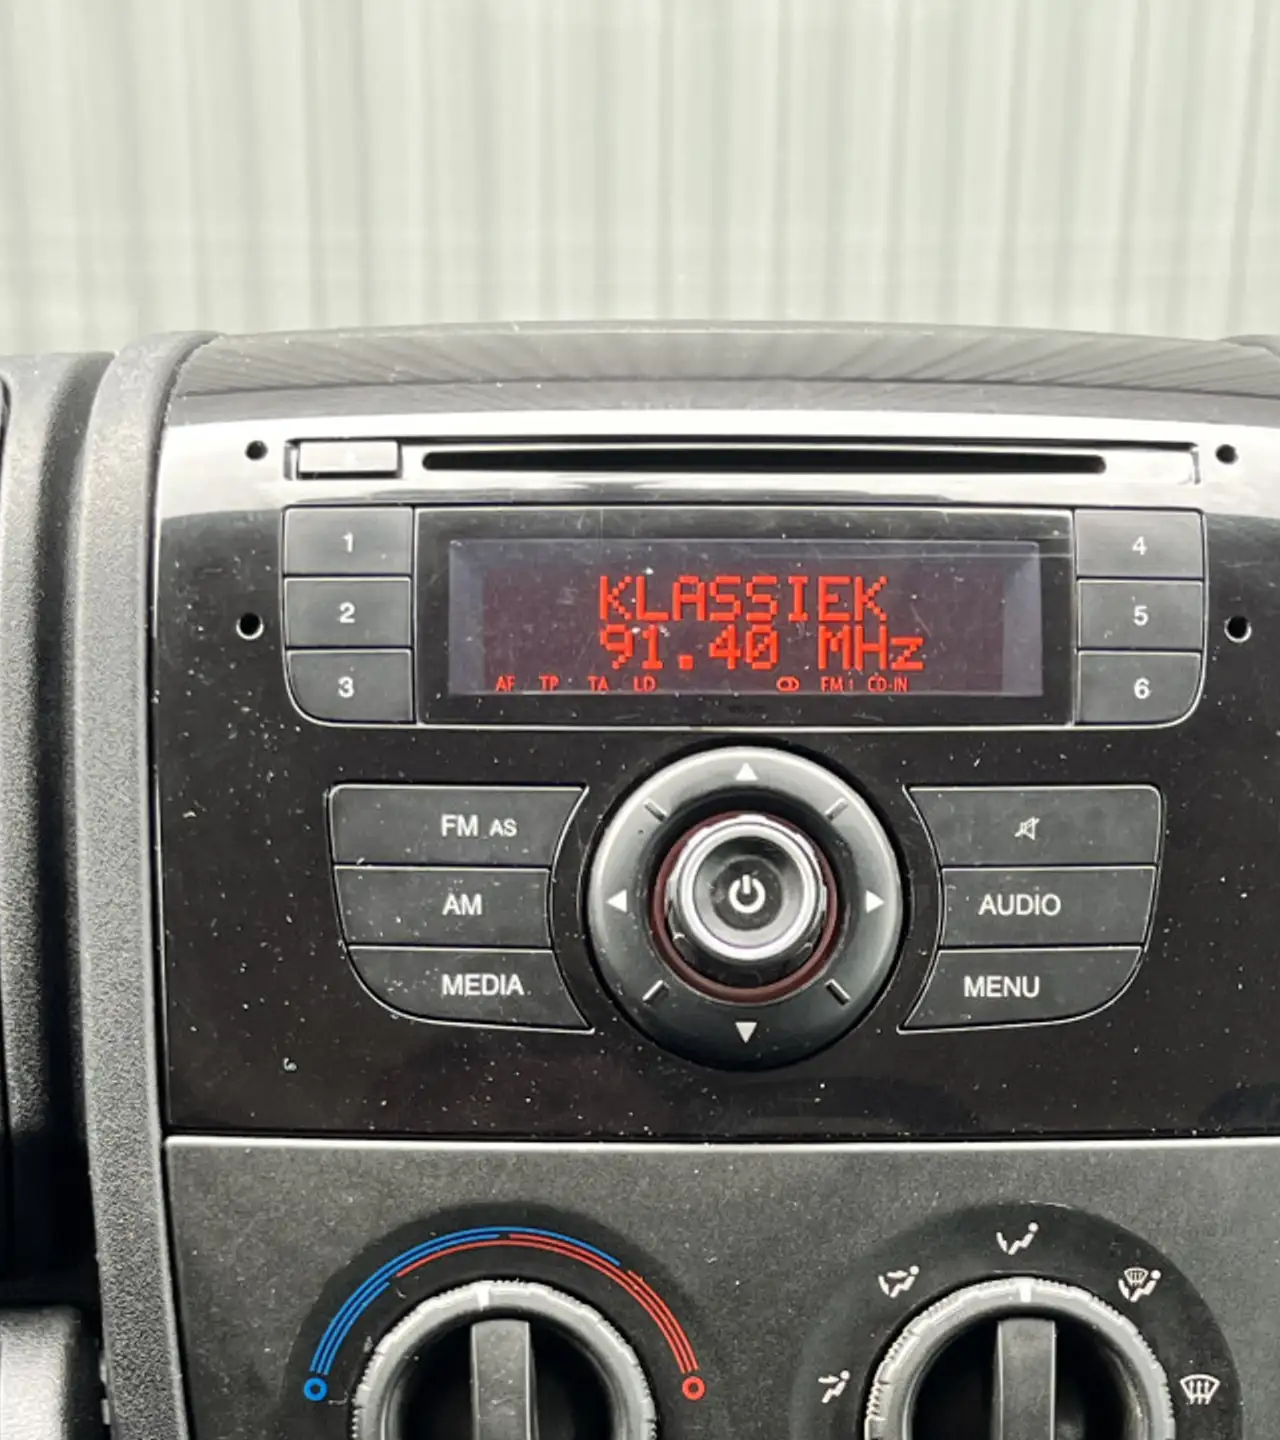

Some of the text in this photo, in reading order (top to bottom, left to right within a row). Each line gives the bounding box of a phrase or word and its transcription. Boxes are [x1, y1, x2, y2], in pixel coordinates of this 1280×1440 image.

[342, 532, 354, 553] 1
[1131, 535, 1148, 556] 4
[599, 575, 888, 621] KLASSIEK
[339, 601, 356, 624] 2
[1133, 604, 1149, 627] 5
[599, 623, 924, 671] 91.40 MHz
[337, 675, 355, 698] 3
[494, 674, 517, 693] AF
[538, 674, 560, 692] TP
[587, 675, 609, 693] TA
[820, 676, 844, 692] FM
[1133, 677, 1151, 700] 6
[441, 813, 518, 837] FM AS
[442, 892, 482, 916] AM
[977, 893, 1062, 917] AUDIO
[440, 972, 525, 999] MEDIA
[963, 975, 1040, 999] MENU
